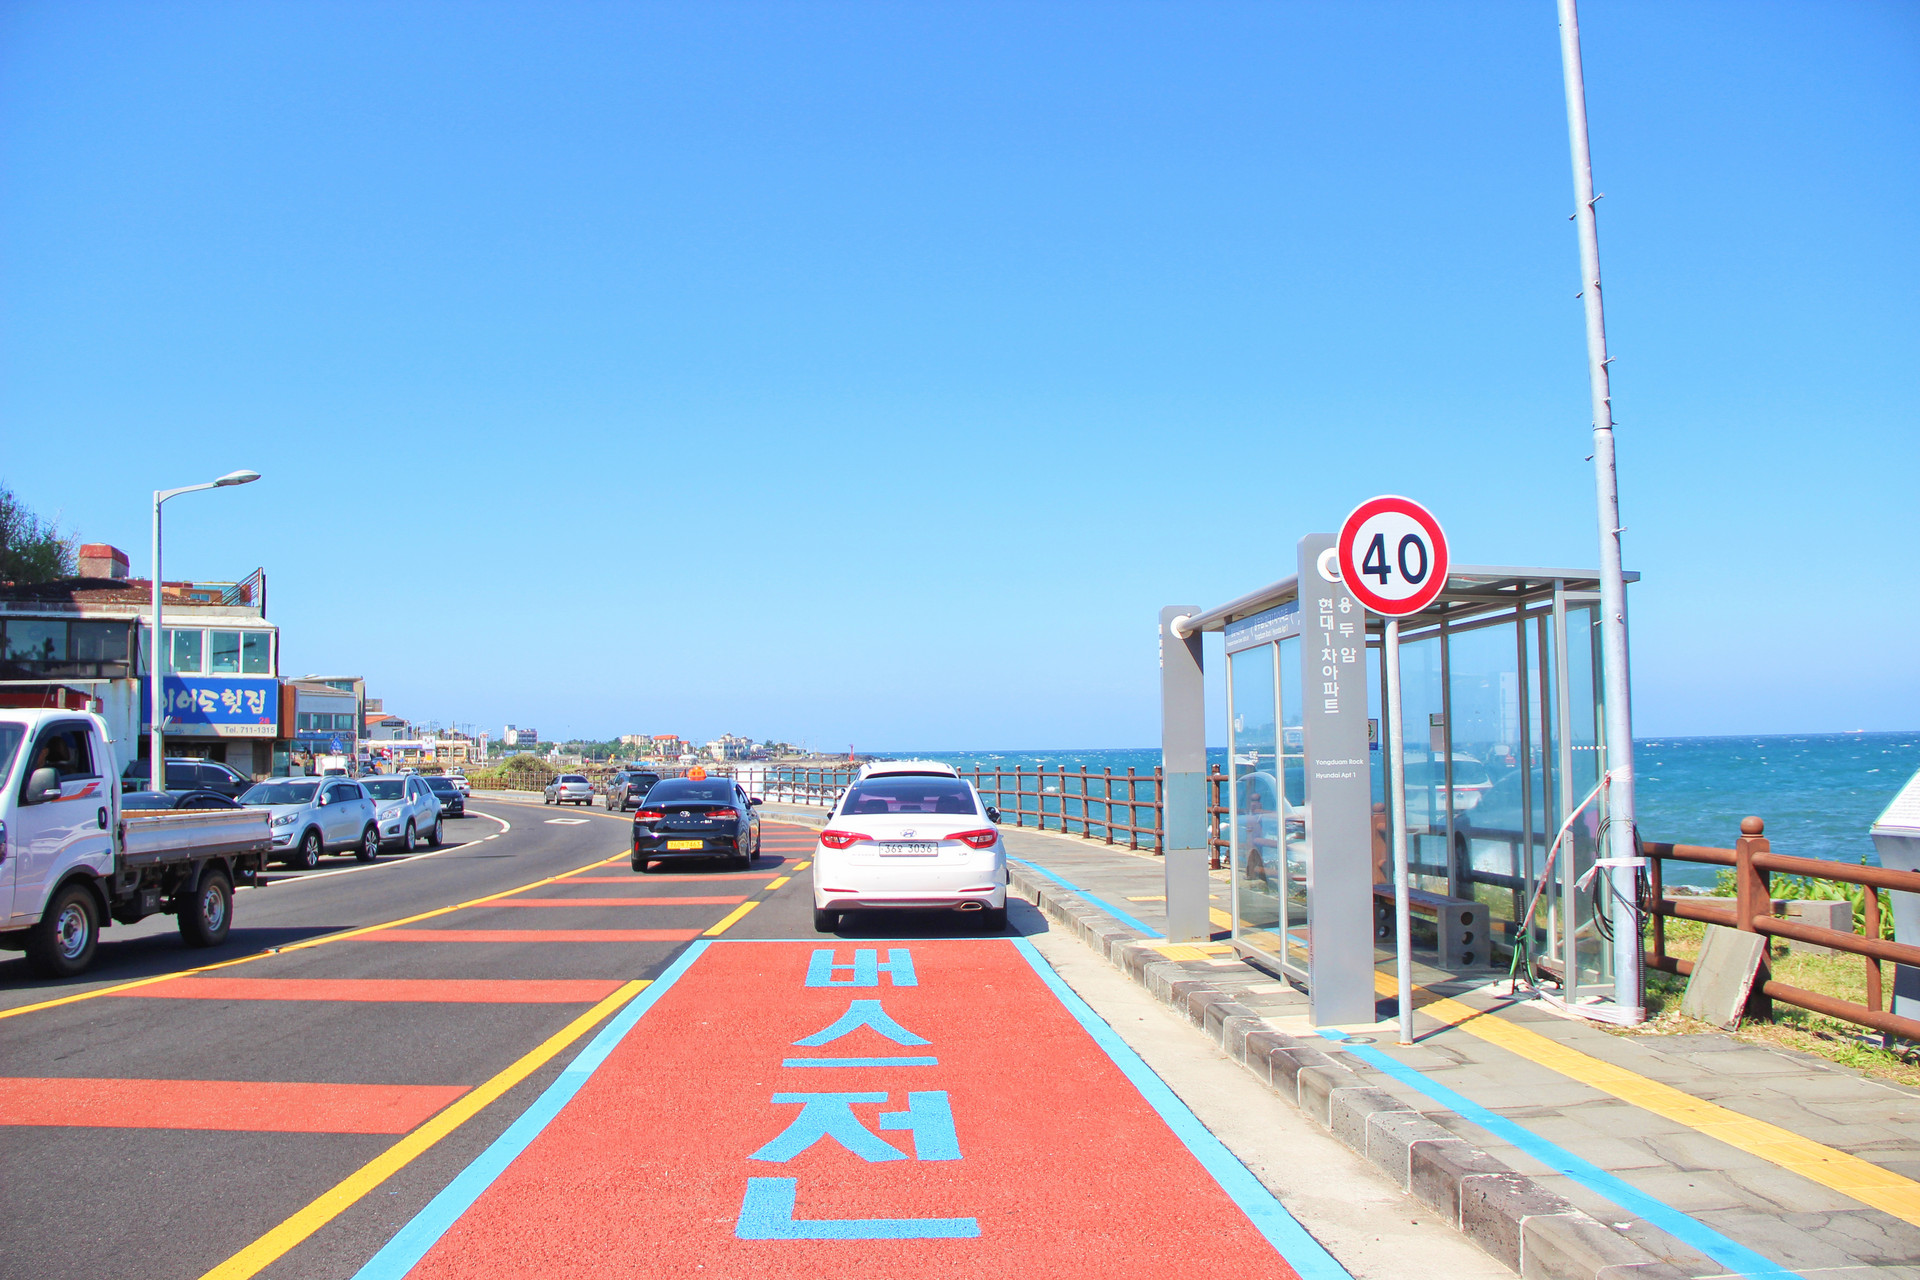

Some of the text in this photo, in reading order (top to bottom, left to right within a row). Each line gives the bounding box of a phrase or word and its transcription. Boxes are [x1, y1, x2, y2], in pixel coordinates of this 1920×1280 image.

[1362, 533, 1428, 585] 40
[1338, 596, 1357, 663] 용두암
[224, 726, 239, 734] Tel.
[907, 843, 932, 854] 3036
